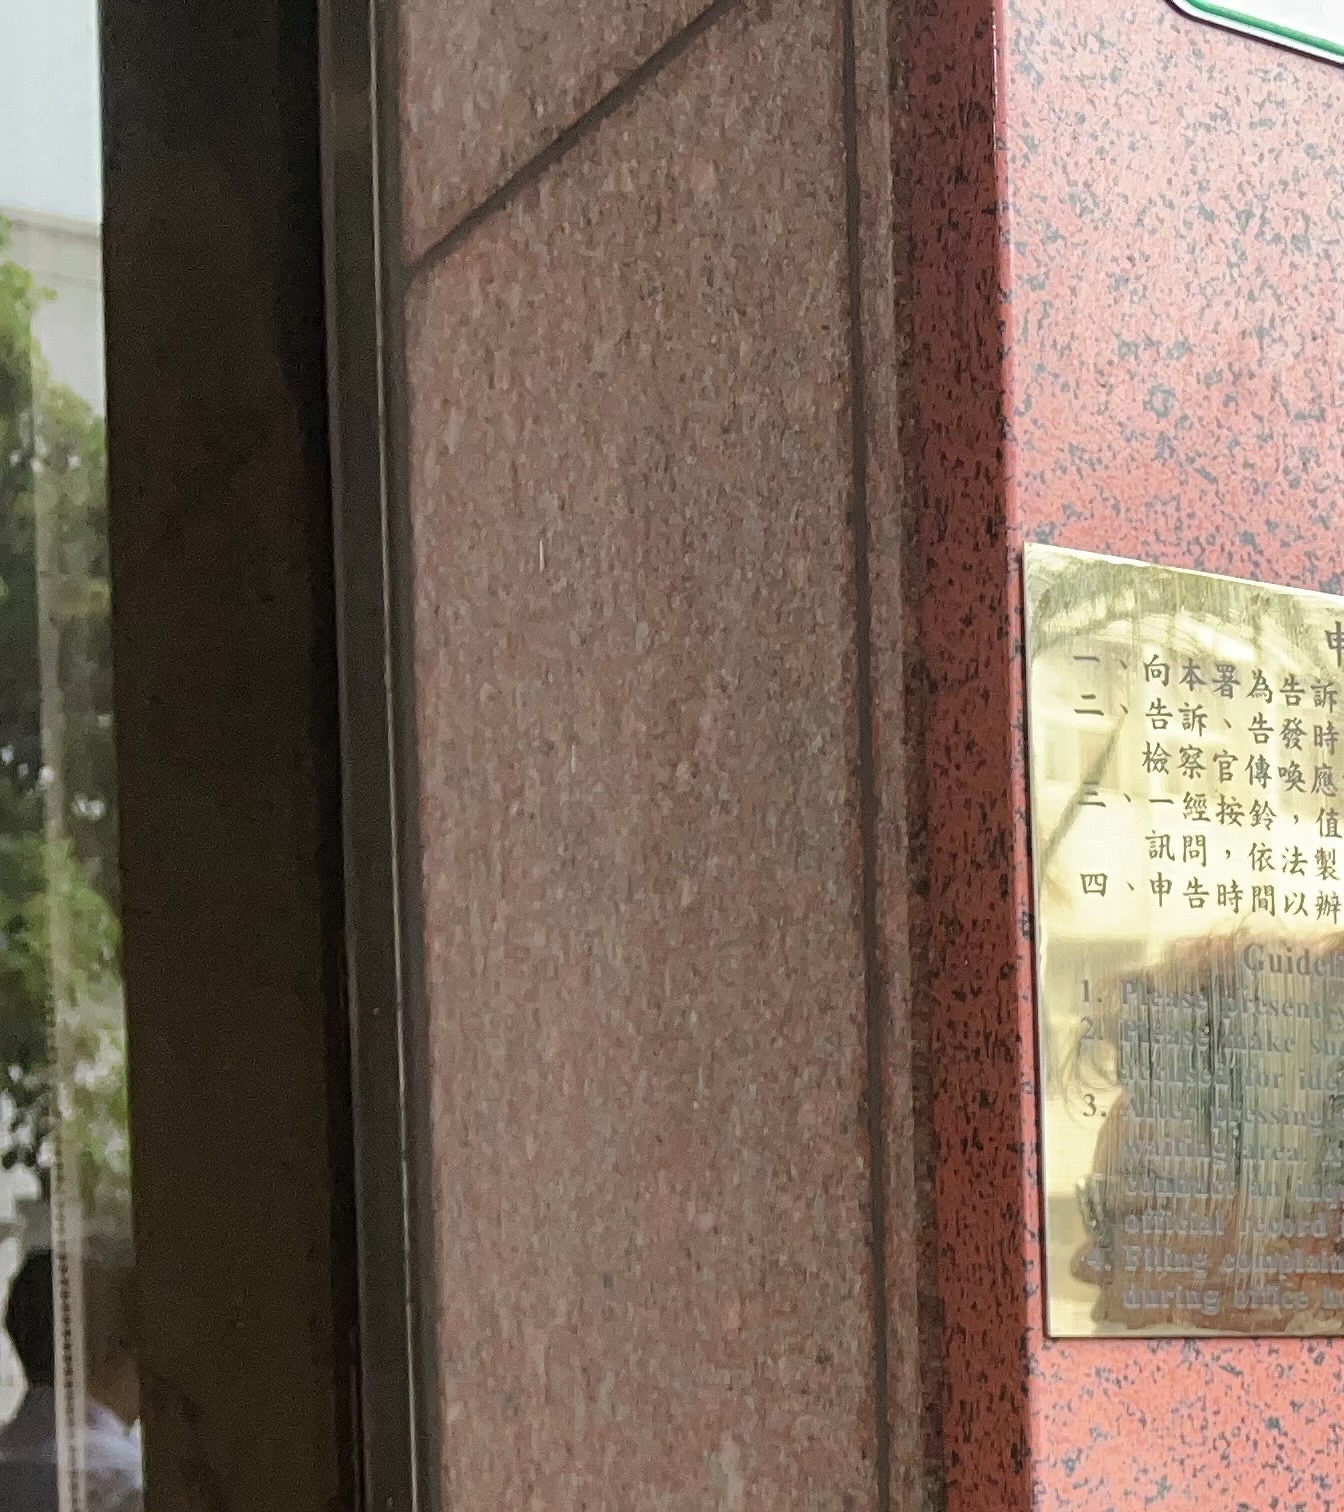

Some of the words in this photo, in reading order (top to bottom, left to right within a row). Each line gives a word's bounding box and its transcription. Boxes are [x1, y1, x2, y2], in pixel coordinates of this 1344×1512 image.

[1081, 979, 1103, 1003] 1.
[1082, 1093, 1107, 1117] 3.
[1123, 1283, 1222, 1316] during
